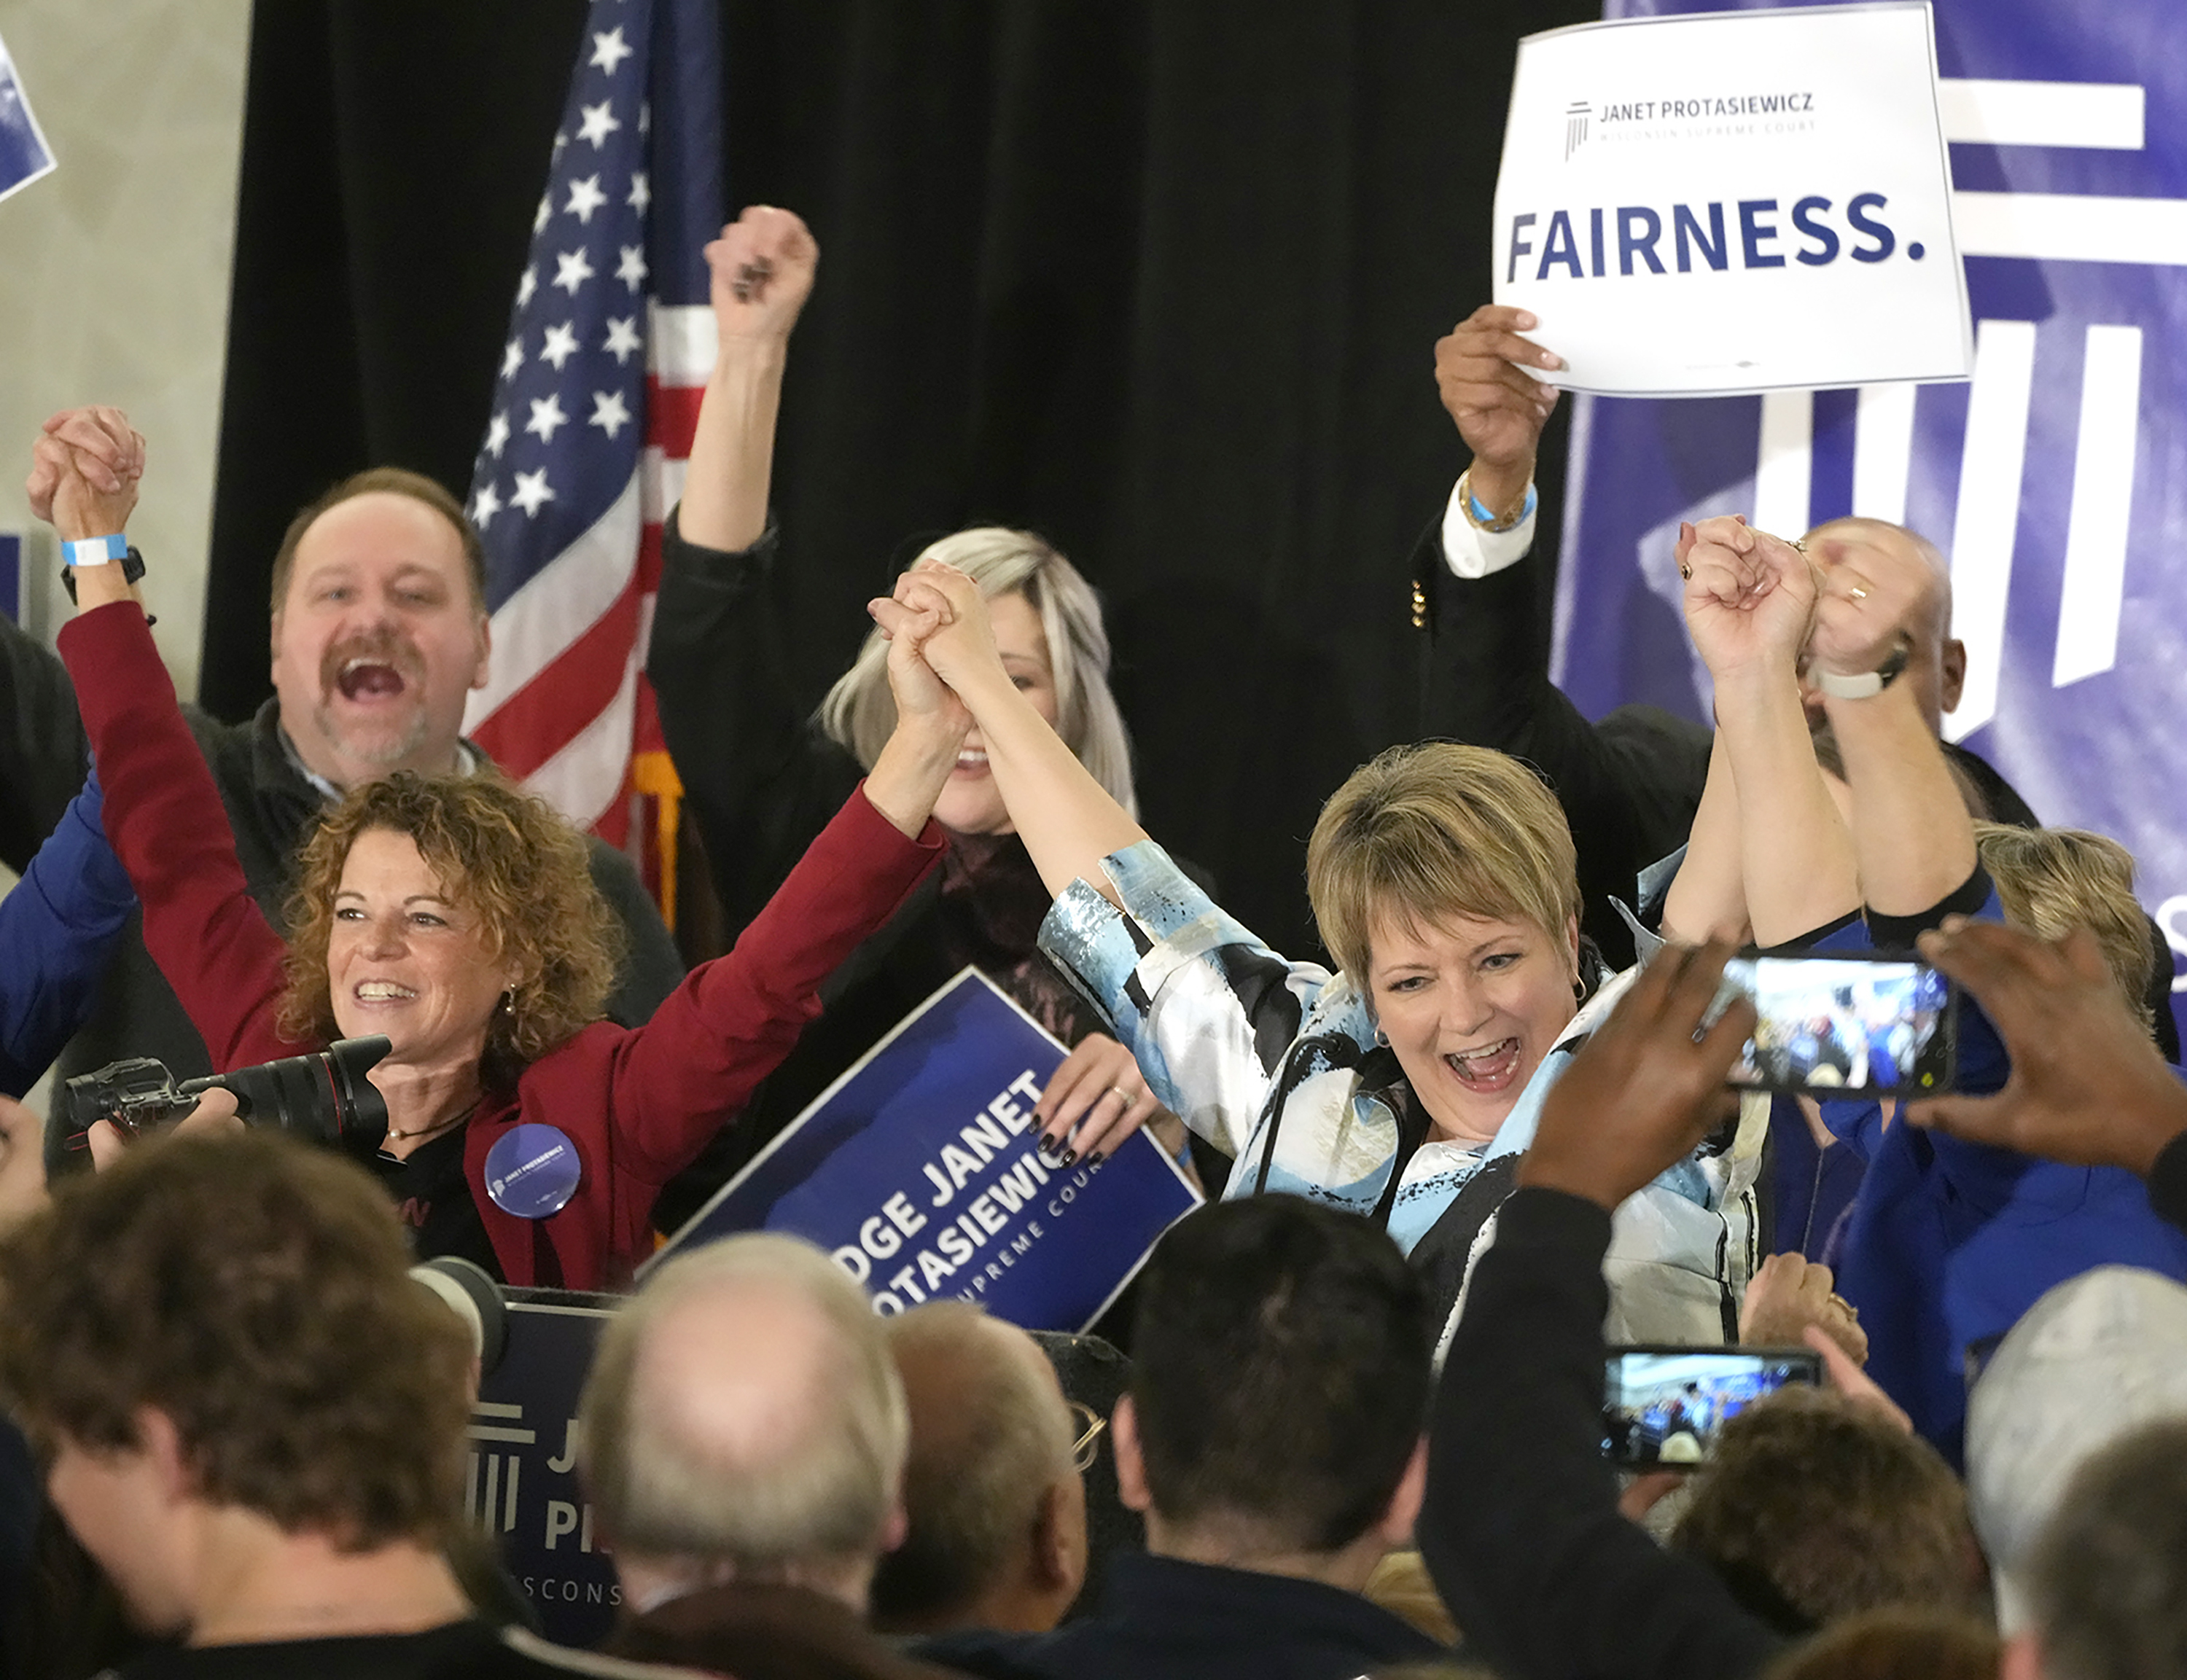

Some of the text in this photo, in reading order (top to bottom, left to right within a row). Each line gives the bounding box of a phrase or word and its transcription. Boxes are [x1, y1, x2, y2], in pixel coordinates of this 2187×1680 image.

[1600, 93, 1814, 122] JANET PROTASIEWICZ
[1507, 192, 1925, 284] FAIRNESS.
[831, 1069, 1042, 1285] DGE JANET
[956, 1221, 1044, 1303] UPREME
[522, 1576, 622, 1606] SCONS
